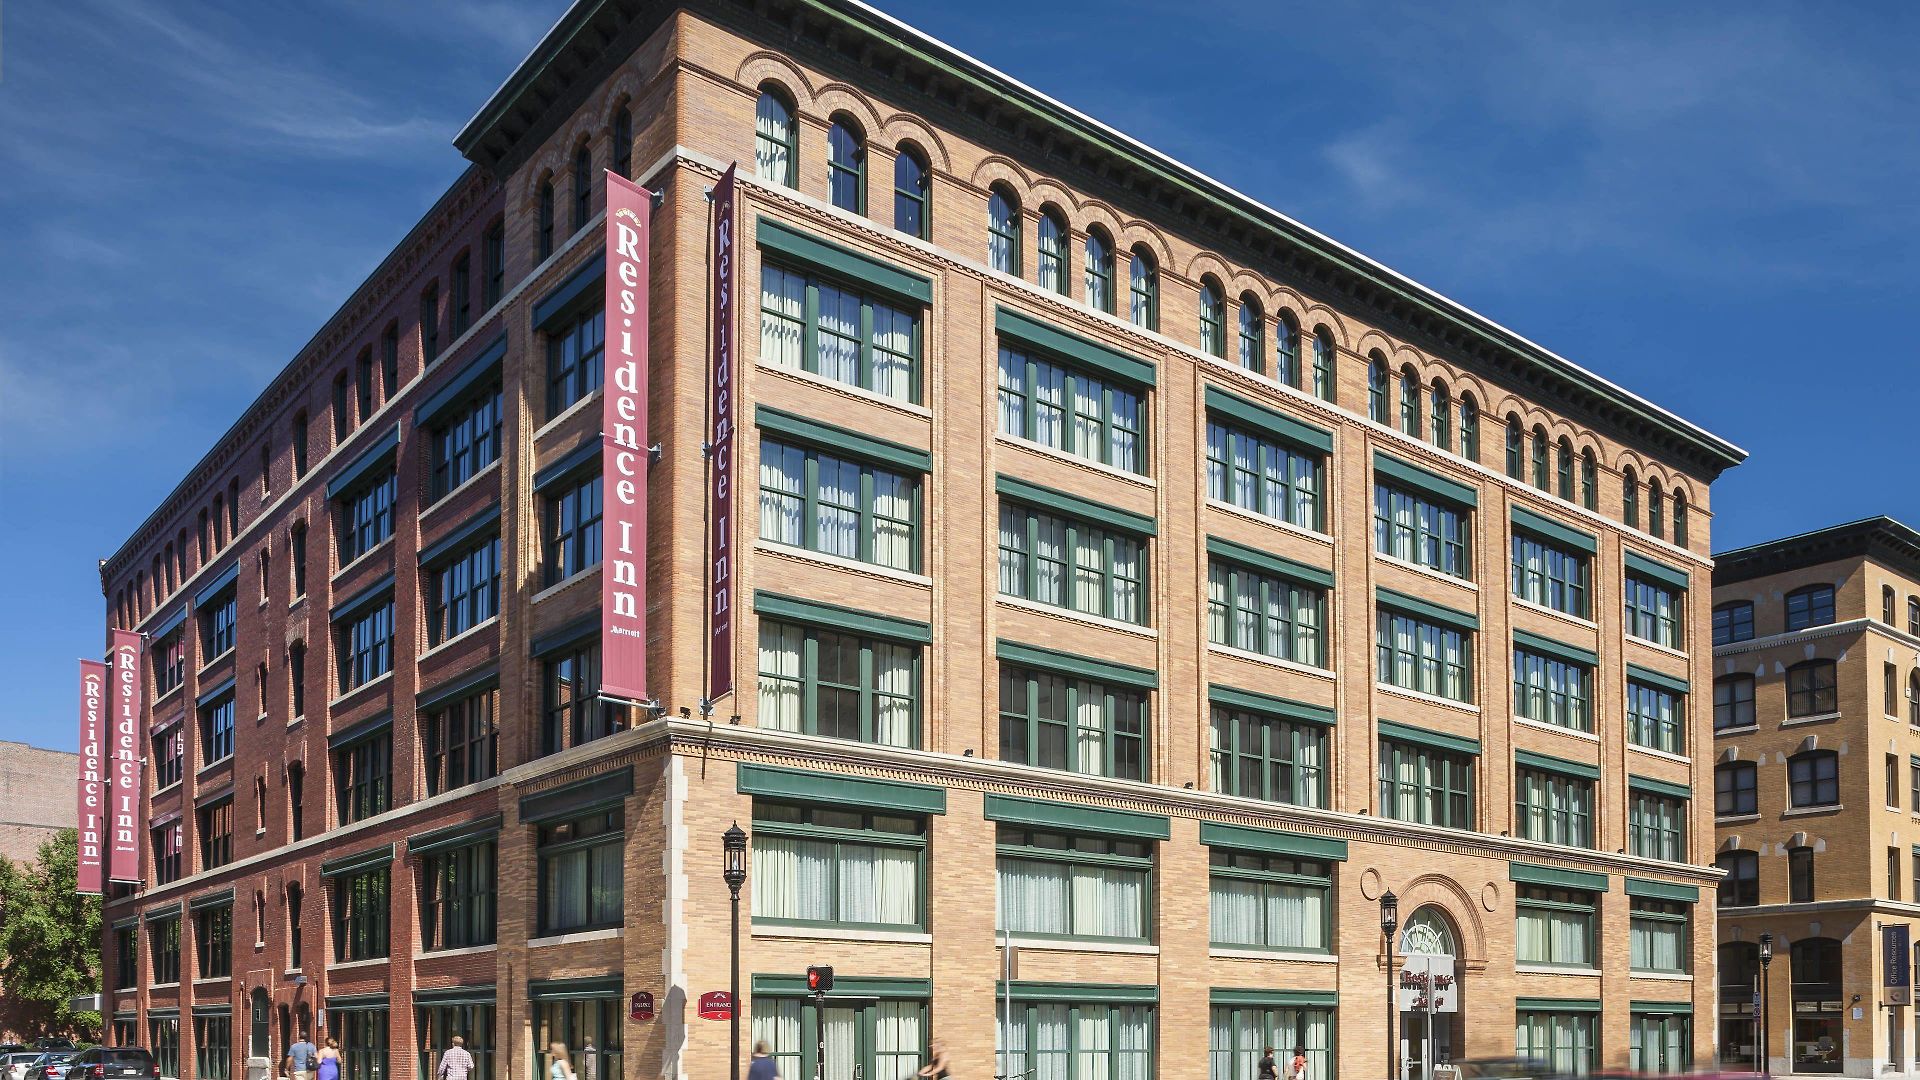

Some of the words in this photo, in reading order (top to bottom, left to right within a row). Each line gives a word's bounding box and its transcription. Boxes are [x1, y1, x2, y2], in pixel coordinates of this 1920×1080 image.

[613, 222, 641, 504] Residence
[715, 218, 731, 499] Residence
[613, 520, 638, 618] Inn
[715, 516, 729, 616] Inn
[84, 681, 100, 807] Residence
[118, 653, 136, 788] Residence
[83, 814, 98, 857] Inn
[117, 796, 133, 842] Inn
